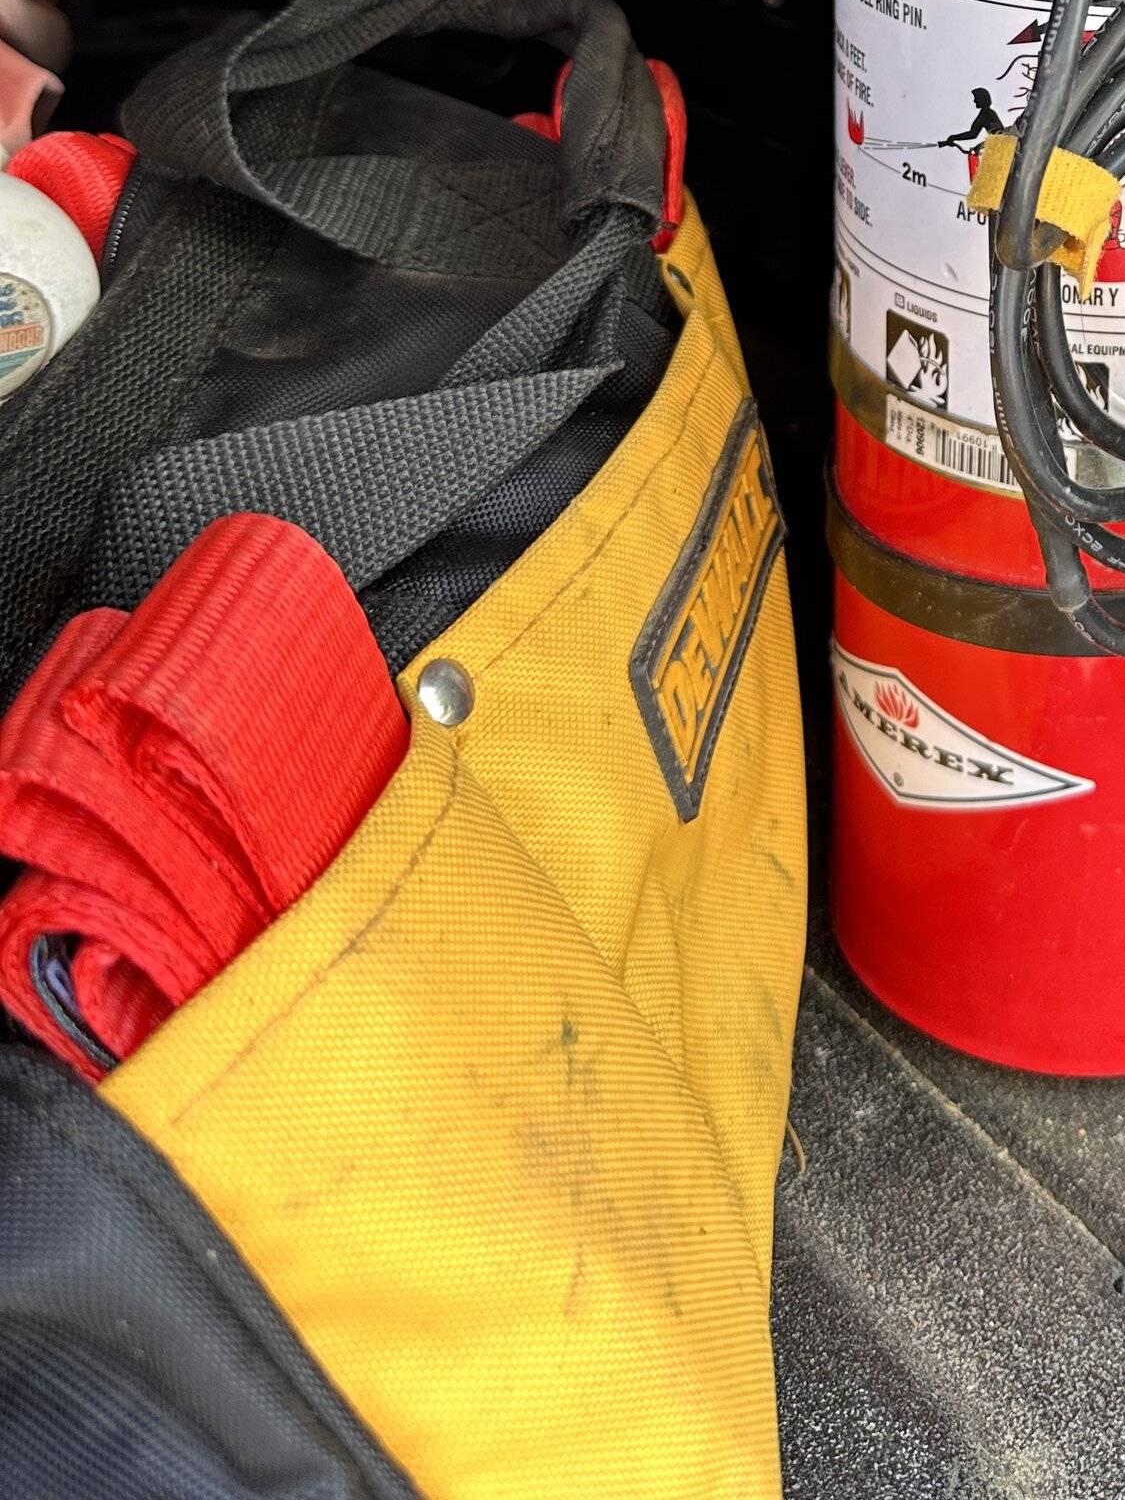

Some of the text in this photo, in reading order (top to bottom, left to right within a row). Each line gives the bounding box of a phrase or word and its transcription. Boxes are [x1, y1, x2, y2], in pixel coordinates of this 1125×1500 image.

[903, 2, 928, 31] PIN.
[850, 43, 868, 73] FEET.
[855, 77, 875, 108] FIRE.
[902, 161, 928, 188] 2m
[854, 197, 873, 227] SIDE.
[907, 301, 938, 323] LIQUIDS
[1109, 287, 1119, 307] Y
[657, 443, 774, 769] DEWALT
[839, 671, 1015, 787] AMEREX
